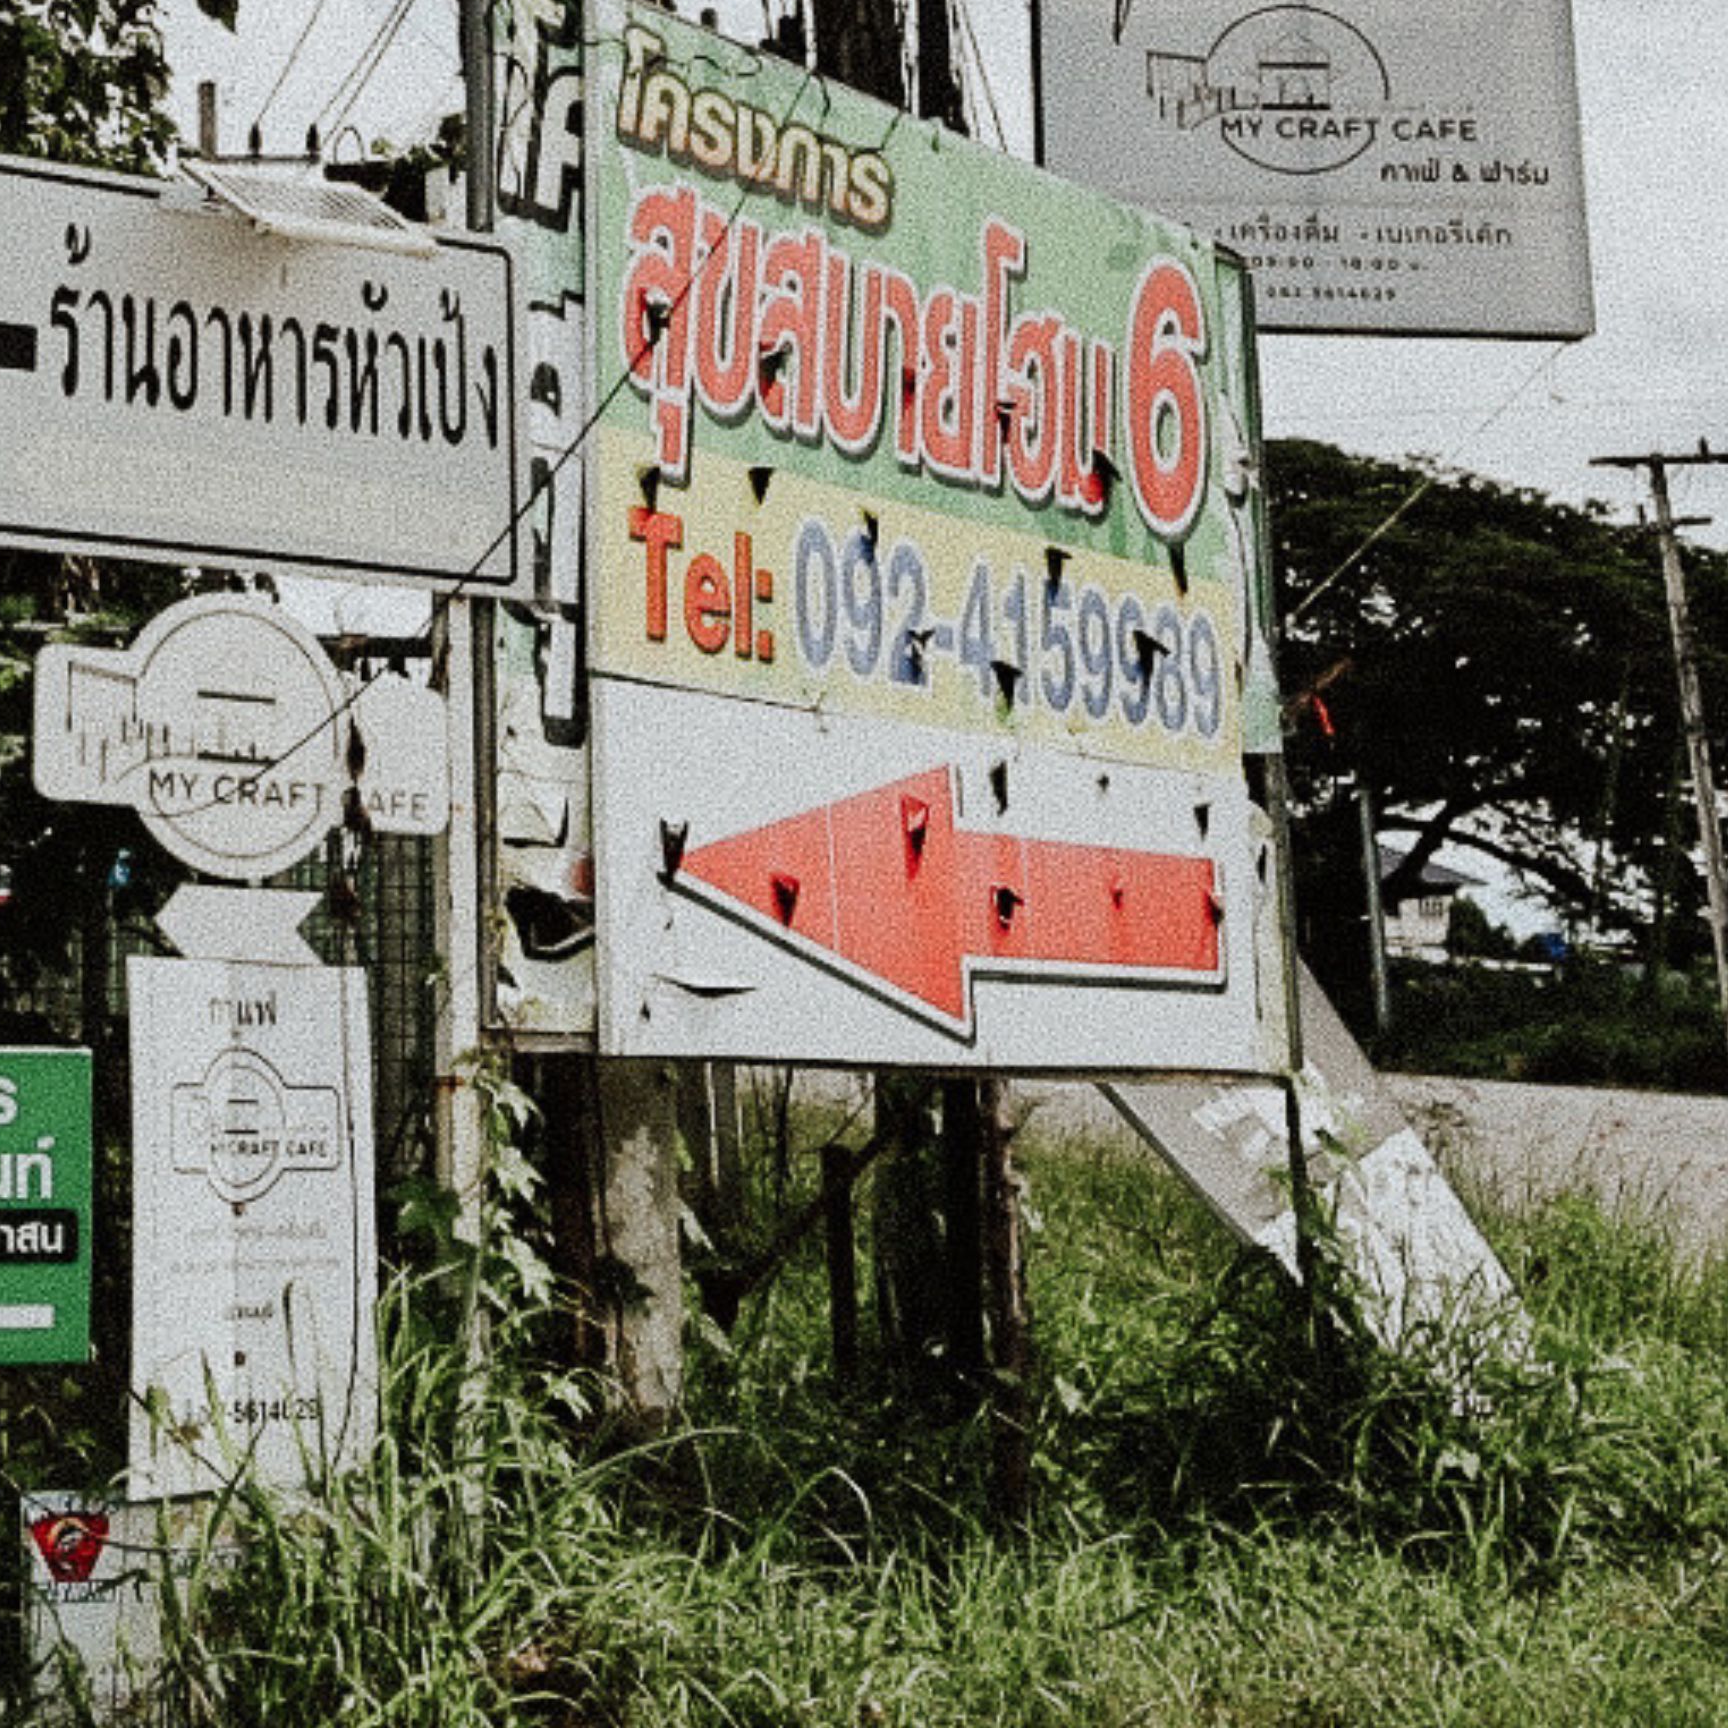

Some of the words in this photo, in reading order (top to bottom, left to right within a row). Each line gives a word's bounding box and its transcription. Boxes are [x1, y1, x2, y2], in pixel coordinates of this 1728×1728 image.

[615, 27, 893, 232] โครงการ
[1220, 117, 1263, 139] MY
[1275, 117, 1376, 141] CRAFT
[1392, 119, 1478, 142] CAFE
[1451, 164, 1471, 183] &
[49, 221, 499, 450] ร้านอาหารหัวเป้ง
[620, 184, 1113, 514] สุขสบายโฮม
[1126, 259, 1208, 539] 6
[628, 504, 774, 664] Tel:
[794, 517, 1225, 742] 092-4159989
[149, 768, 197, 800] MY
[213, 774, 329, 812] CRAFT
[341, 789, 430, 821] AFE
